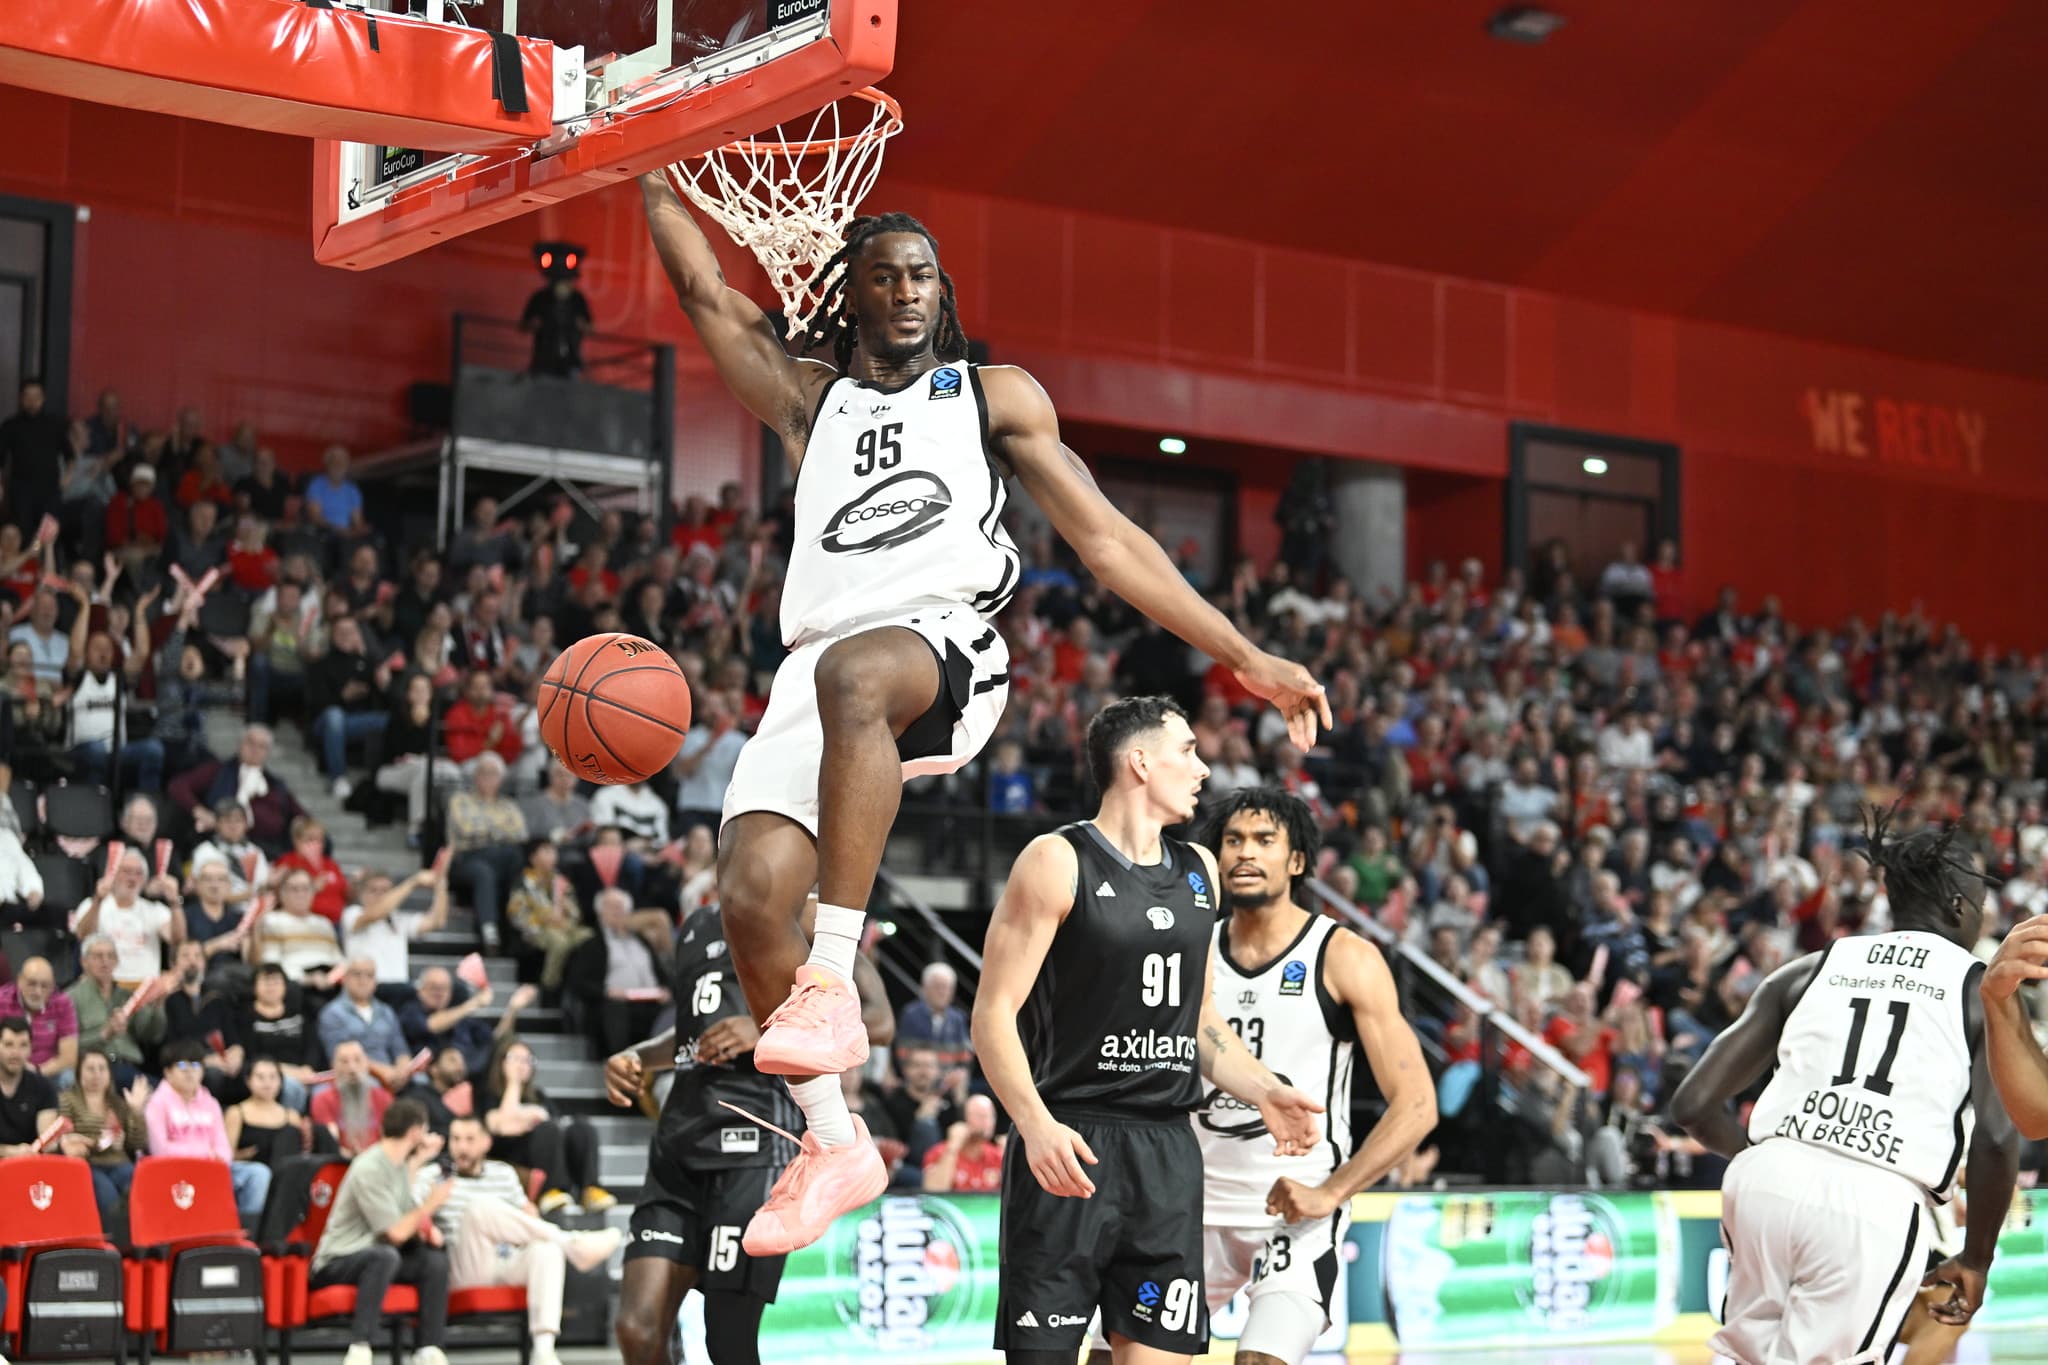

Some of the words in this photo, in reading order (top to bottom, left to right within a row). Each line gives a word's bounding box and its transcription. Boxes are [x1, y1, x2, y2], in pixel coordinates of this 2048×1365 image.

[383, 154, 416, 176] EuroCup
[853, 421, 904, 477] 95
[844, 498, 928, 525] cosea
[1866, 943, 1930, 969] GACH
[692, 971, 723, 1016] 15
[1142, 953, 1182, 1007] 91
[1828, 974, 1887, 989] Charles
[1892, 974, 1946, 1001] Rema
[1097, 1060, 1118, 1071] safe
[1100, 1028, 1197, 1061] axilaris
[1831, 997, 1910, 1096] 11
[1802, 1089, 1894, 1132] BOURG
[1775, 1114, 1809, 1140] EN
[1812, 1123, 1904, 1165] BRESSE
[708, 1225, 741, 1272] 15
[1160, 1278, 1199, 1335] 91
